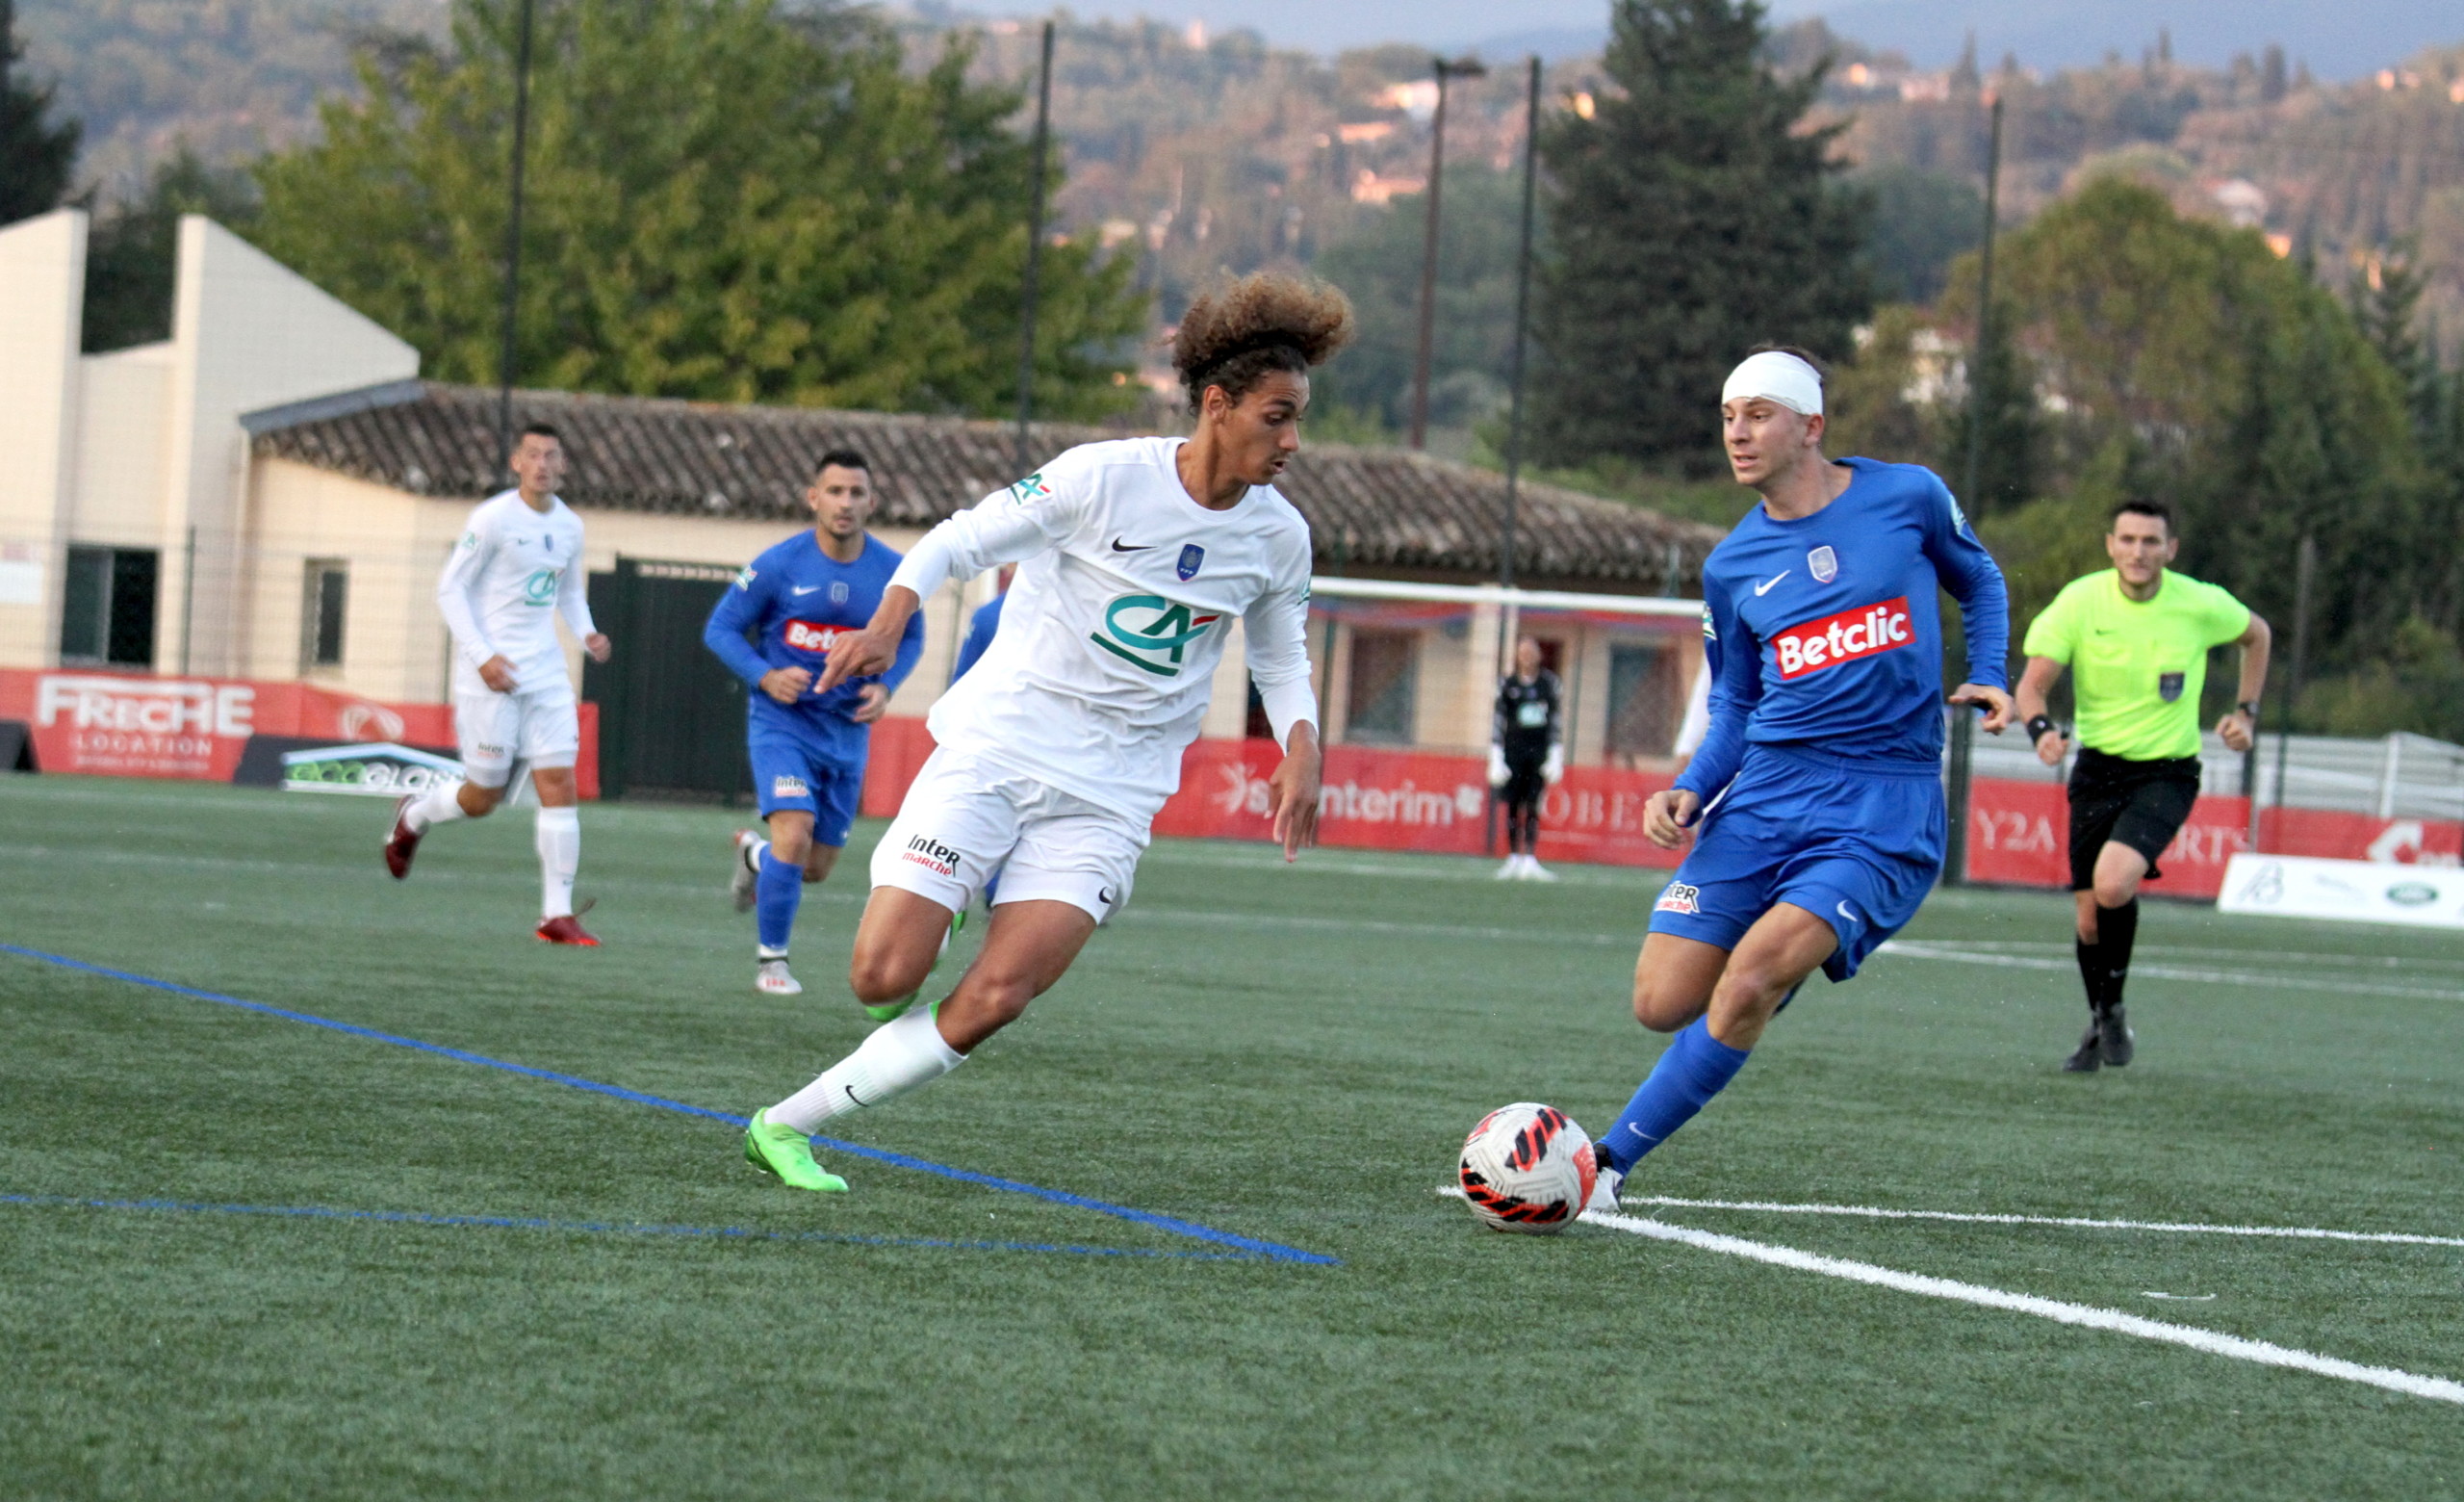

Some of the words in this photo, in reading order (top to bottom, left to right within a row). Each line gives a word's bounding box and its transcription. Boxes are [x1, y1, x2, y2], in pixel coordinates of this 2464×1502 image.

[789, 622, 838, 650] Bet
[1778, 606, 1908, 674] Betclic
[74, 733, 213, 755] LOCATION
